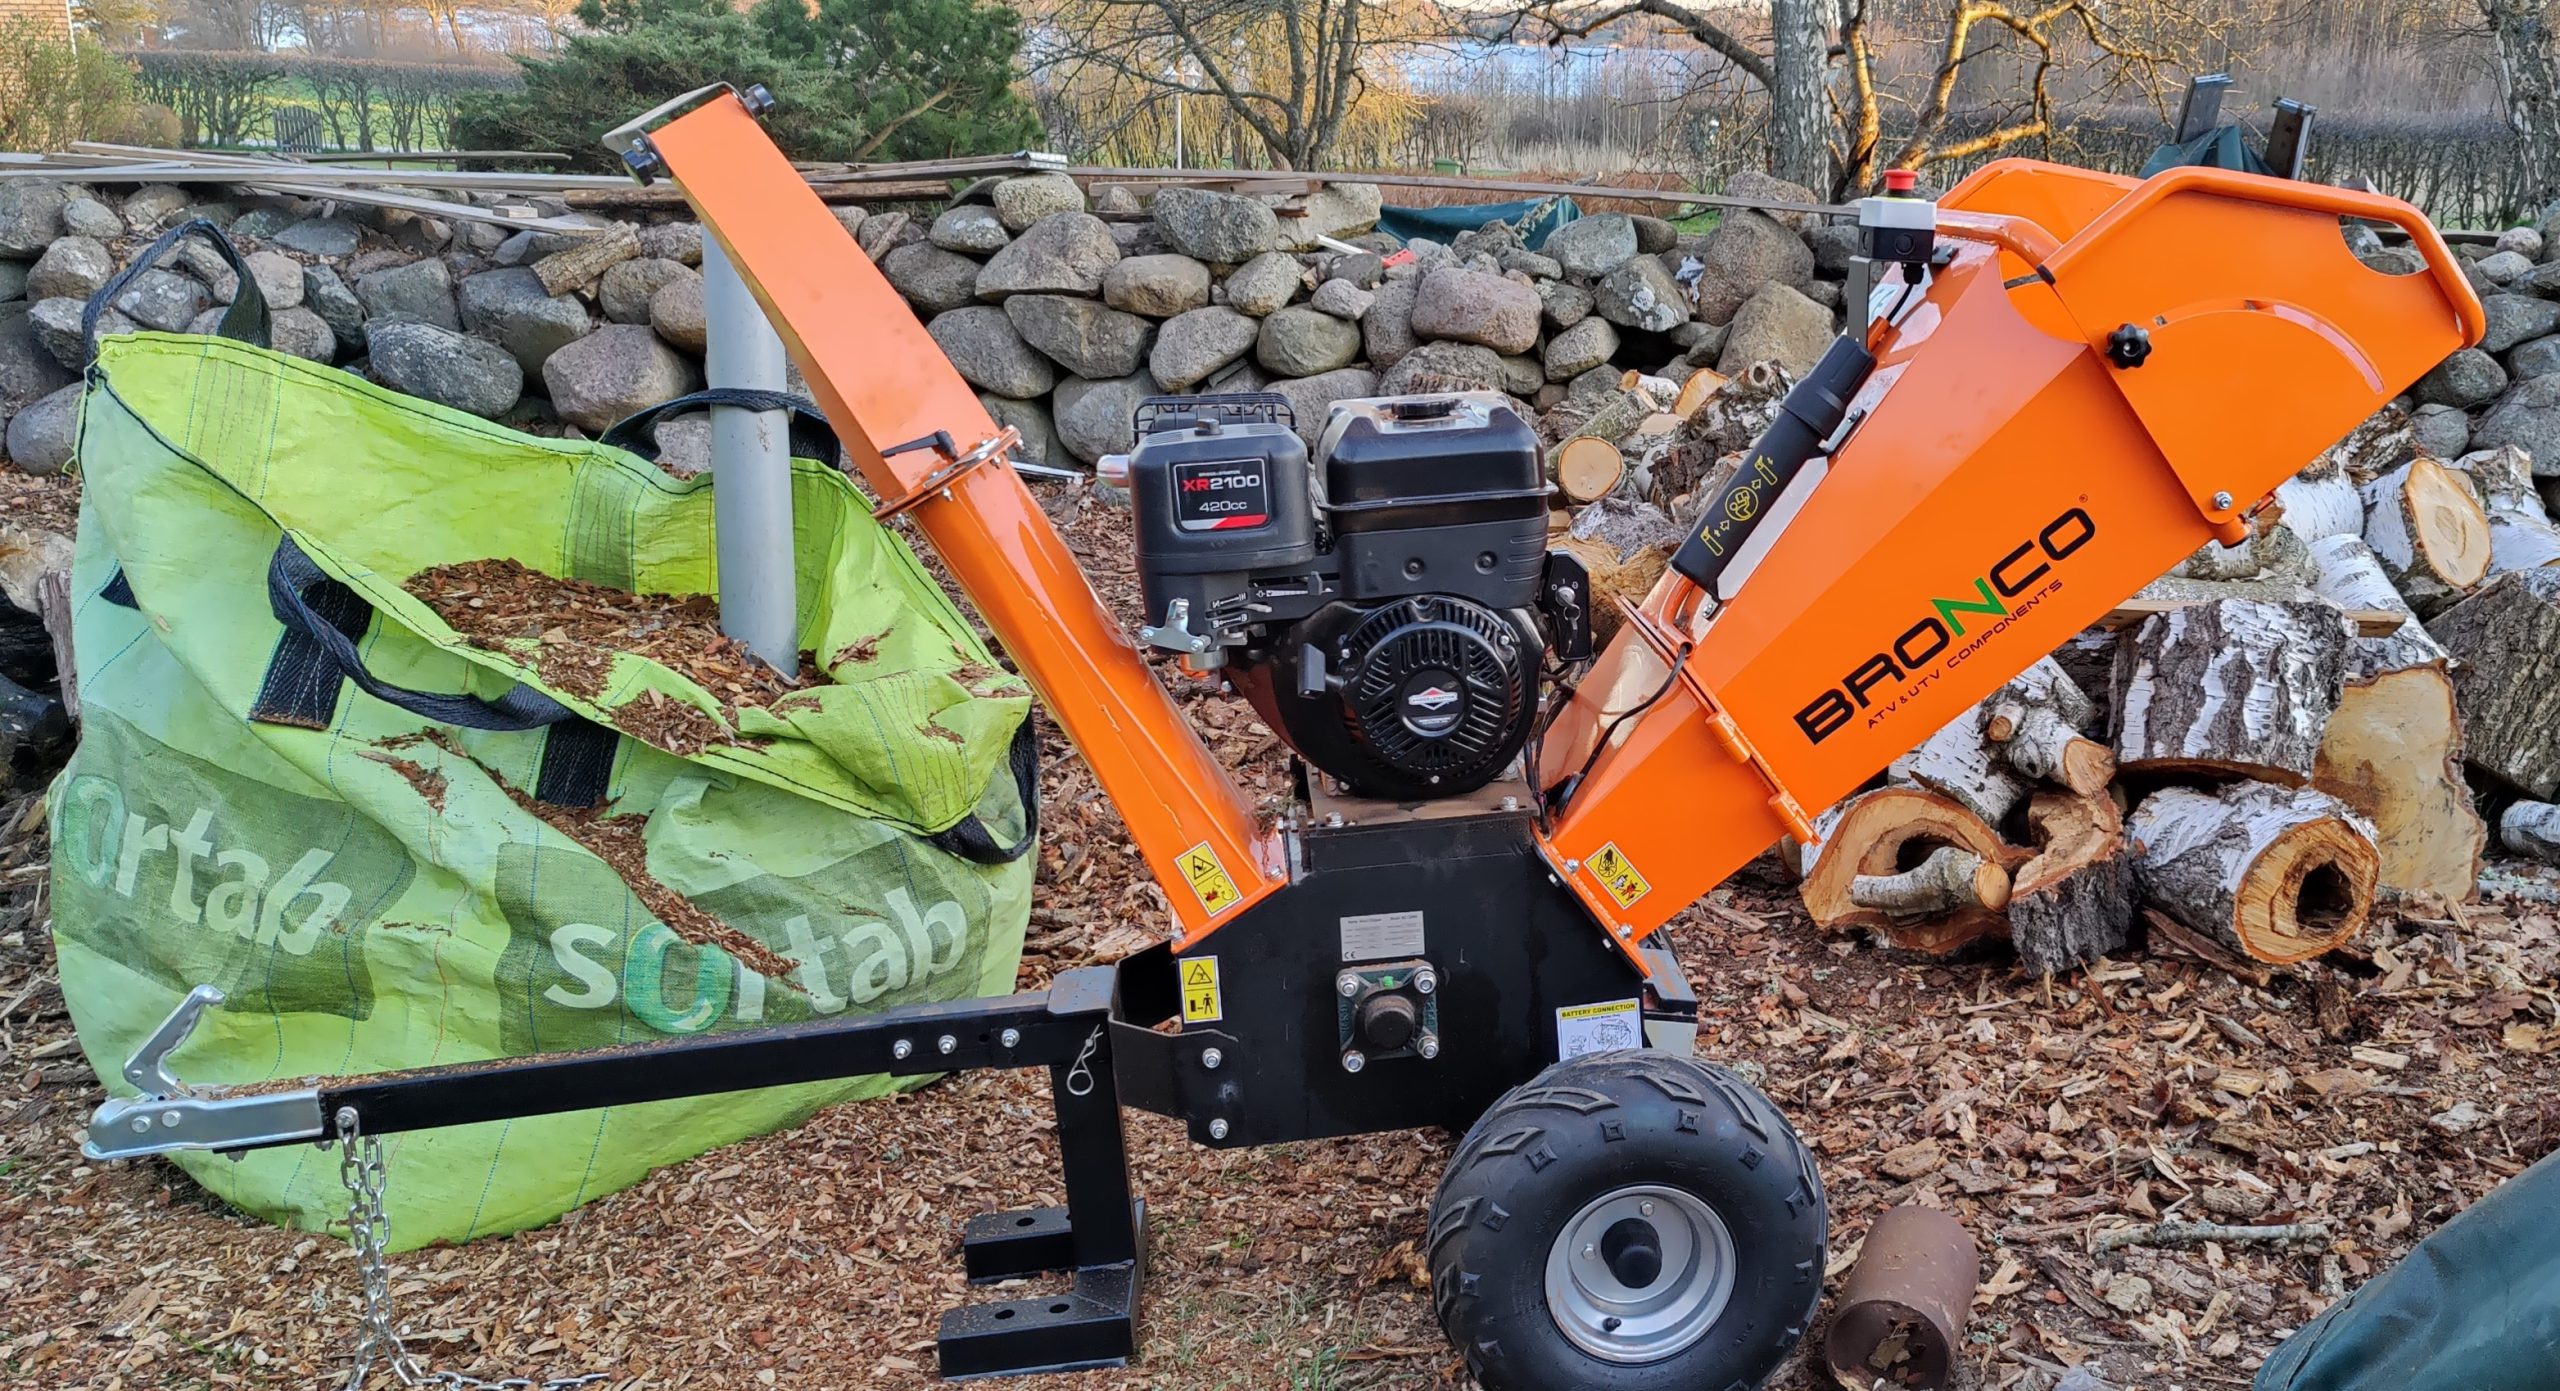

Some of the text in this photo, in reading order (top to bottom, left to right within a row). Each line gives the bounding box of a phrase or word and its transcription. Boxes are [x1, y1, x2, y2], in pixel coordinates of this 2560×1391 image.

[1183, 475, 1260, 492] XR2100
[1199, 500, 1247, 513] 420cc
[1793, 507, 2096, 745] BRONCO
[1946, 578, 2064, 669] COMPONENTS
[51, 772, 352, 956] ortab
[1561, 1009, 1591, 1018] BATTERY
[1592, 1002, 1636, 1014] CONNECTION
